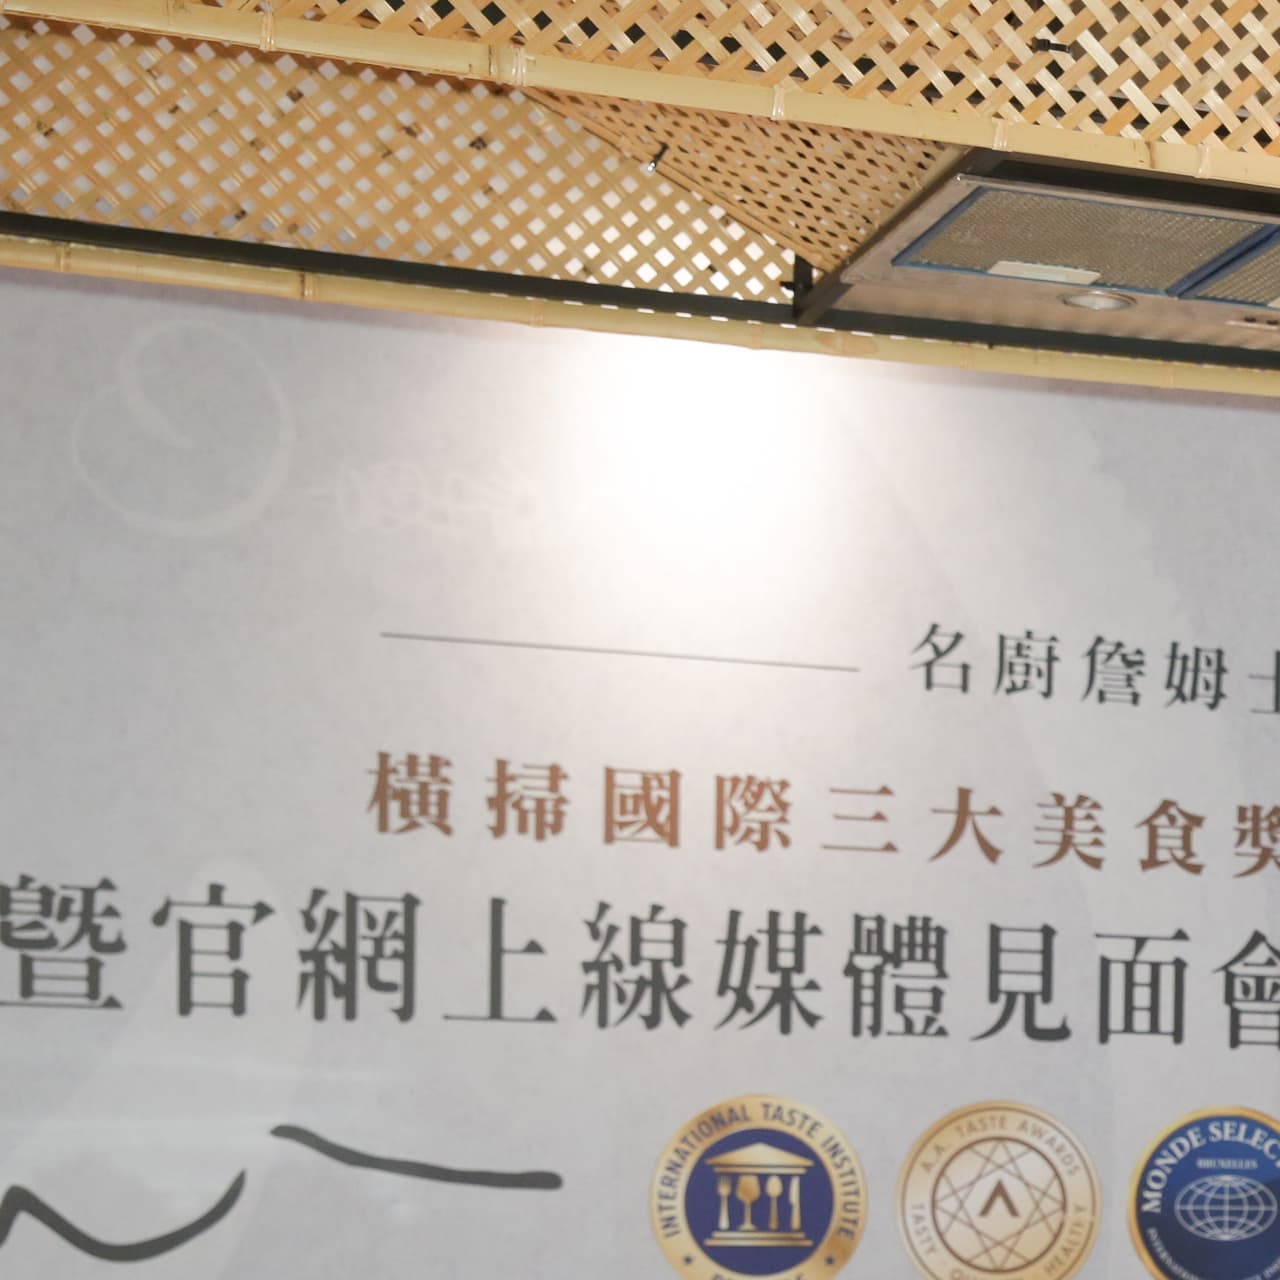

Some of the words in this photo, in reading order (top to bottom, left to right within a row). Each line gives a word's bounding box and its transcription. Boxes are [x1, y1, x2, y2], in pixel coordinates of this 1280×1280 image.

[658, 1104, 752, 1238] INTERNATIONAL
[761, 1102, 822, 1138] TASTE
[821, 1135, 860, 1240] INSTITUTE
[955, 1116, 1008, 1137] TASTE
[1017, 1119, 1081, 1176] AWARDS
[1141, 1126, 1208, 1214] MONDE
[911, 1202, 936, 1256] TASTY
